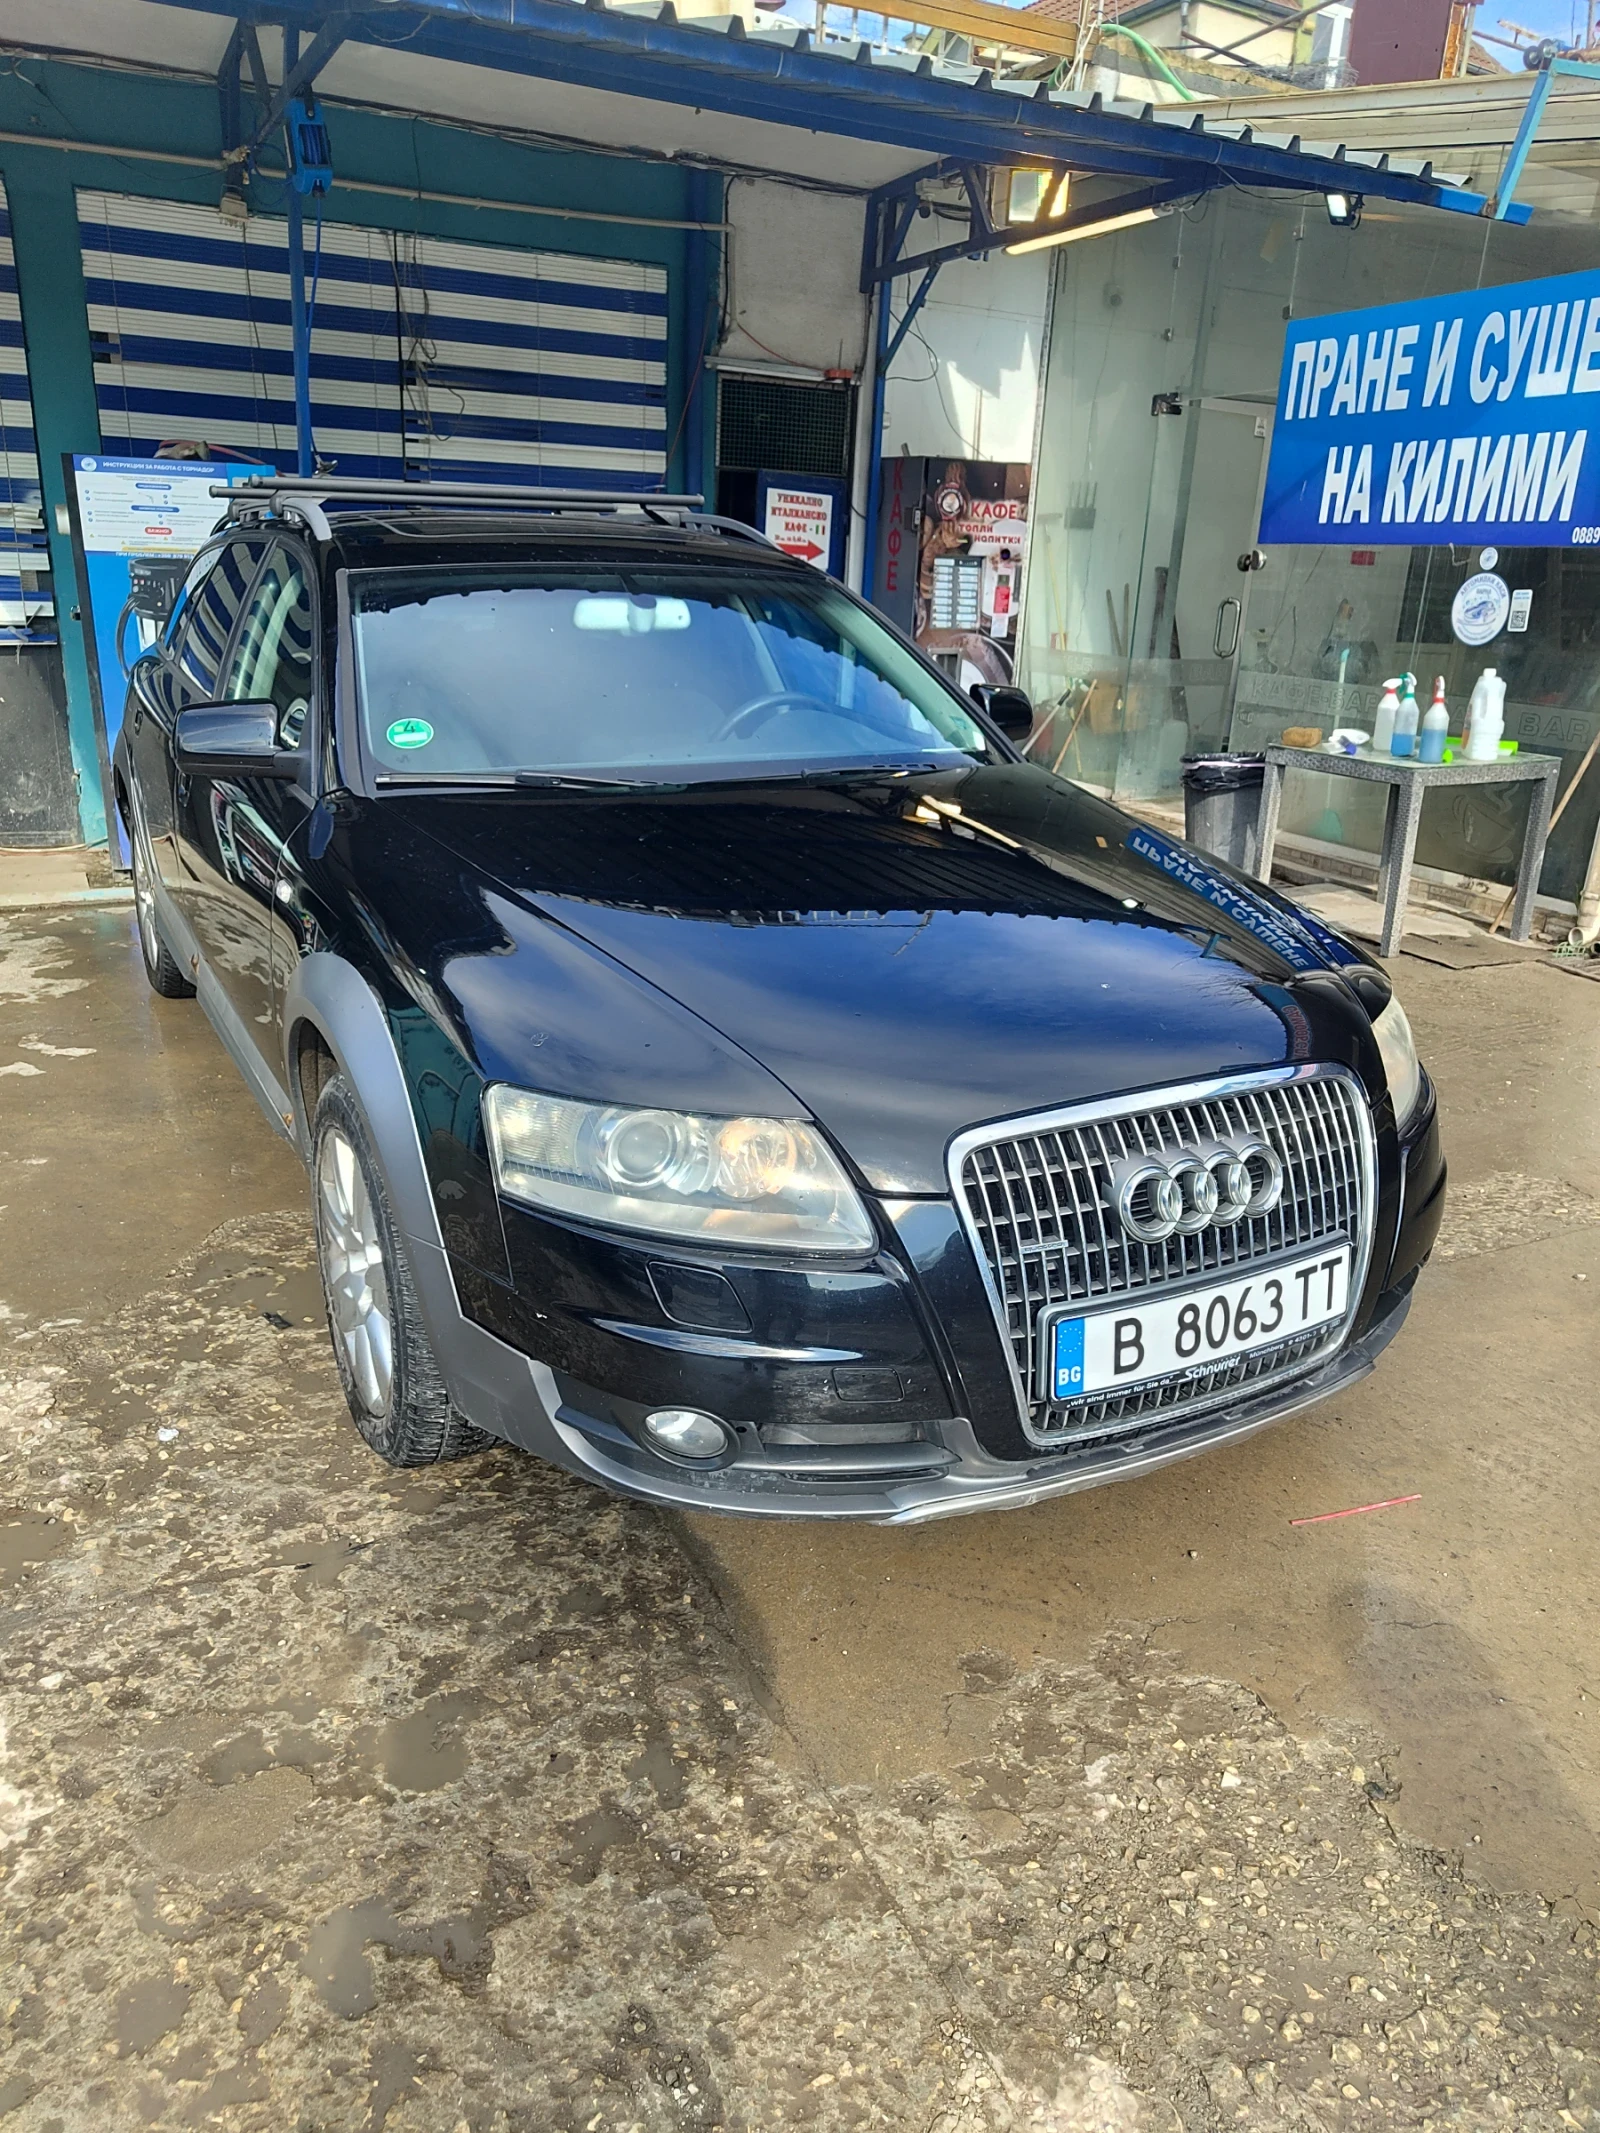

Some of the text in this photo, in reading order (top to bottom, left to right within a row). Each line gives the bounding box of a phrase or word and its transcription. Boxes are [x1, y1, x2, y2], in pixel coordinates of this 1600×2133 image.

[1285, 324, 1420, 420] ПРАНЕ
[1422, 318, 1463, 407] И
[102, 461, 145, 470] ИНСТРУКЦИИ
[152, 464, 176, 472] РАБОТА
[1318, 429, 1587, 524] НА КИЛИМИ
[777, 493, 823, 507] УНИКАЛНО
[771, 506, 827, 521] ИТАЛИАНСКО
[971, 502, 1018, 519] КАФЕ
[784, 522, 807, 533] КАФЕ
[885, 458, 904, 592] КАФЕ
[1572, 526, 1600, 544] 0889
[403, 720, 416, 733] 4
[1518, 712, 1592, 744] BAR
[1114, 1256, 1343, 1375] B 8063 TT
[1249, 1343, 1285, 1359] Münchberg
[1058, 1366, 1082, 1386] BG
[1185, 1354, 1241, 1380] Schnurrer
[1087, 1393, 1105, 1403] sind
[1107, 1388, 1132, 1400] immer
[1133, 1384, 1145, 1393] für
[1147, 1381, 1158, 1390] Sie
